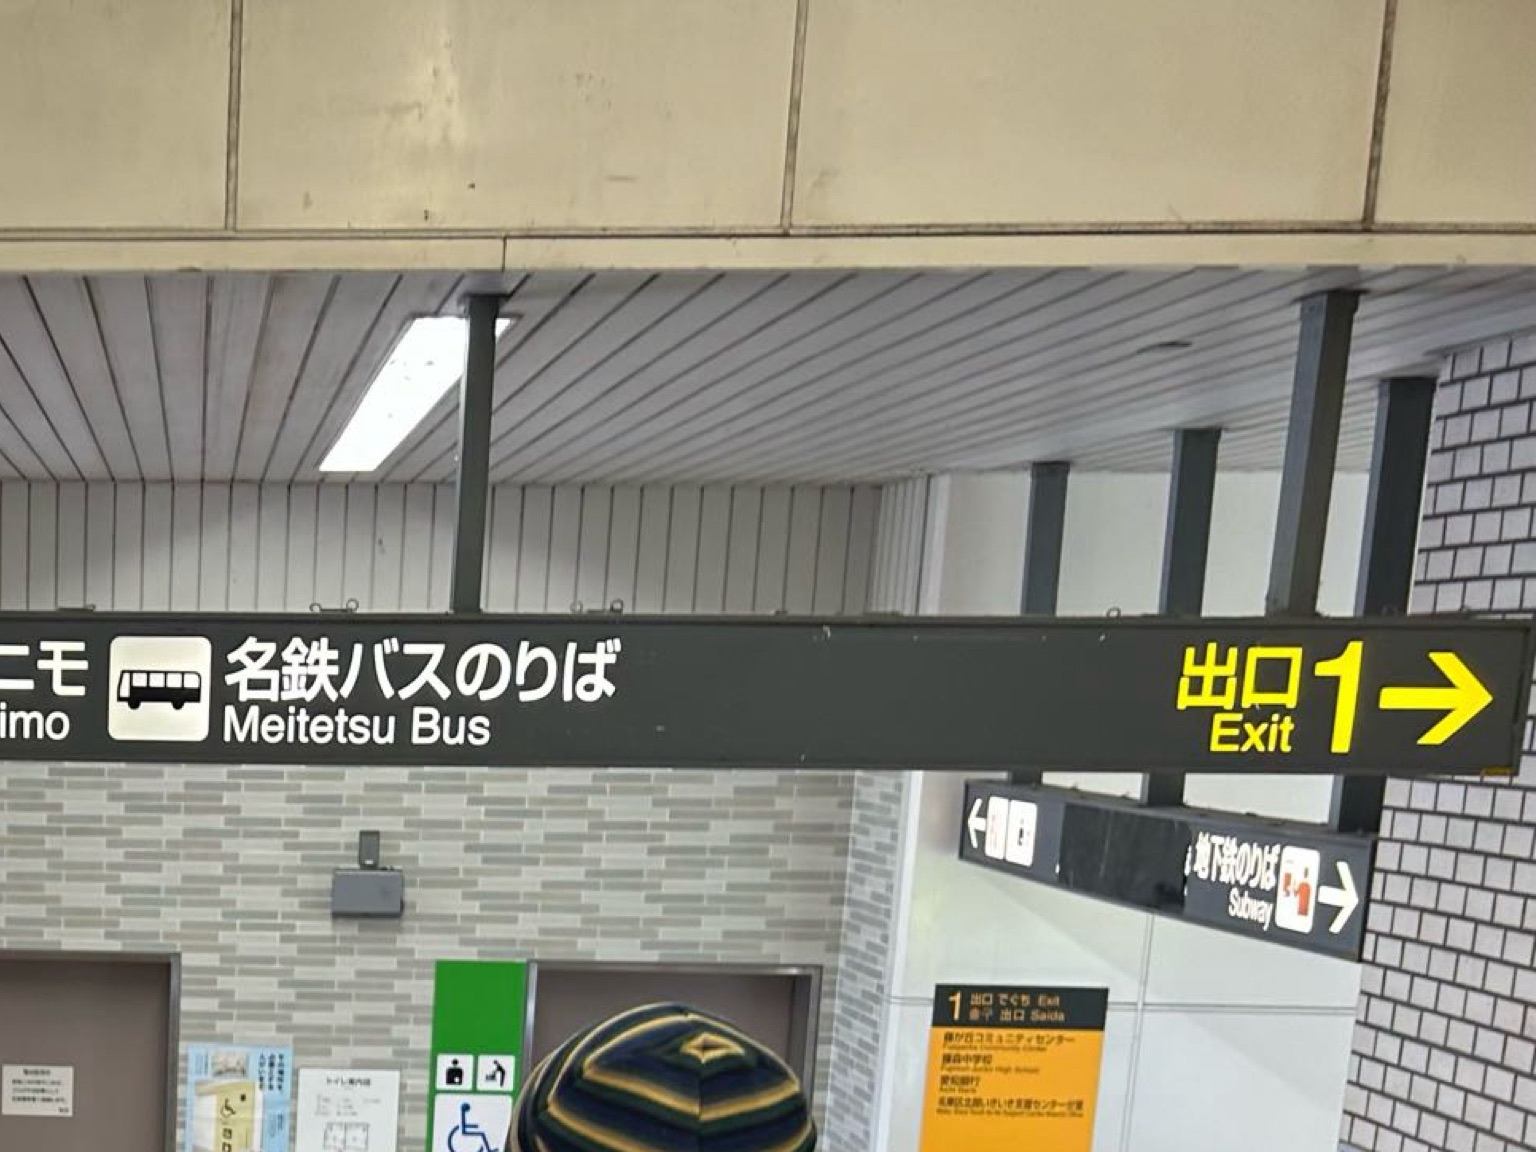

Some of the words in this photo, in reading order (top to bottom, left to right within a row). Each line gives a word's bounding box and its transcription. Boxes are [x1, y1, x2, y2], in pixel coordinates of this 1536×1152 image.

[224, 636, 622, 702] 名鉄バスのりば
[1176, 642, 1303, 710] 出口
[1314, 641, 1363, 754] 1
[222, 705, 396, 745] Meitetsu
[411, 708, 491, 746] Bus
[1209, 713, 1295, 753] Exit
[1194, 831, 1281, 891] 地下鉄のりば
[1228, 887, 1275, 931] Subway
[949, 991, 961, 1021] 1
[970, 992, 993, 1006] 出口
